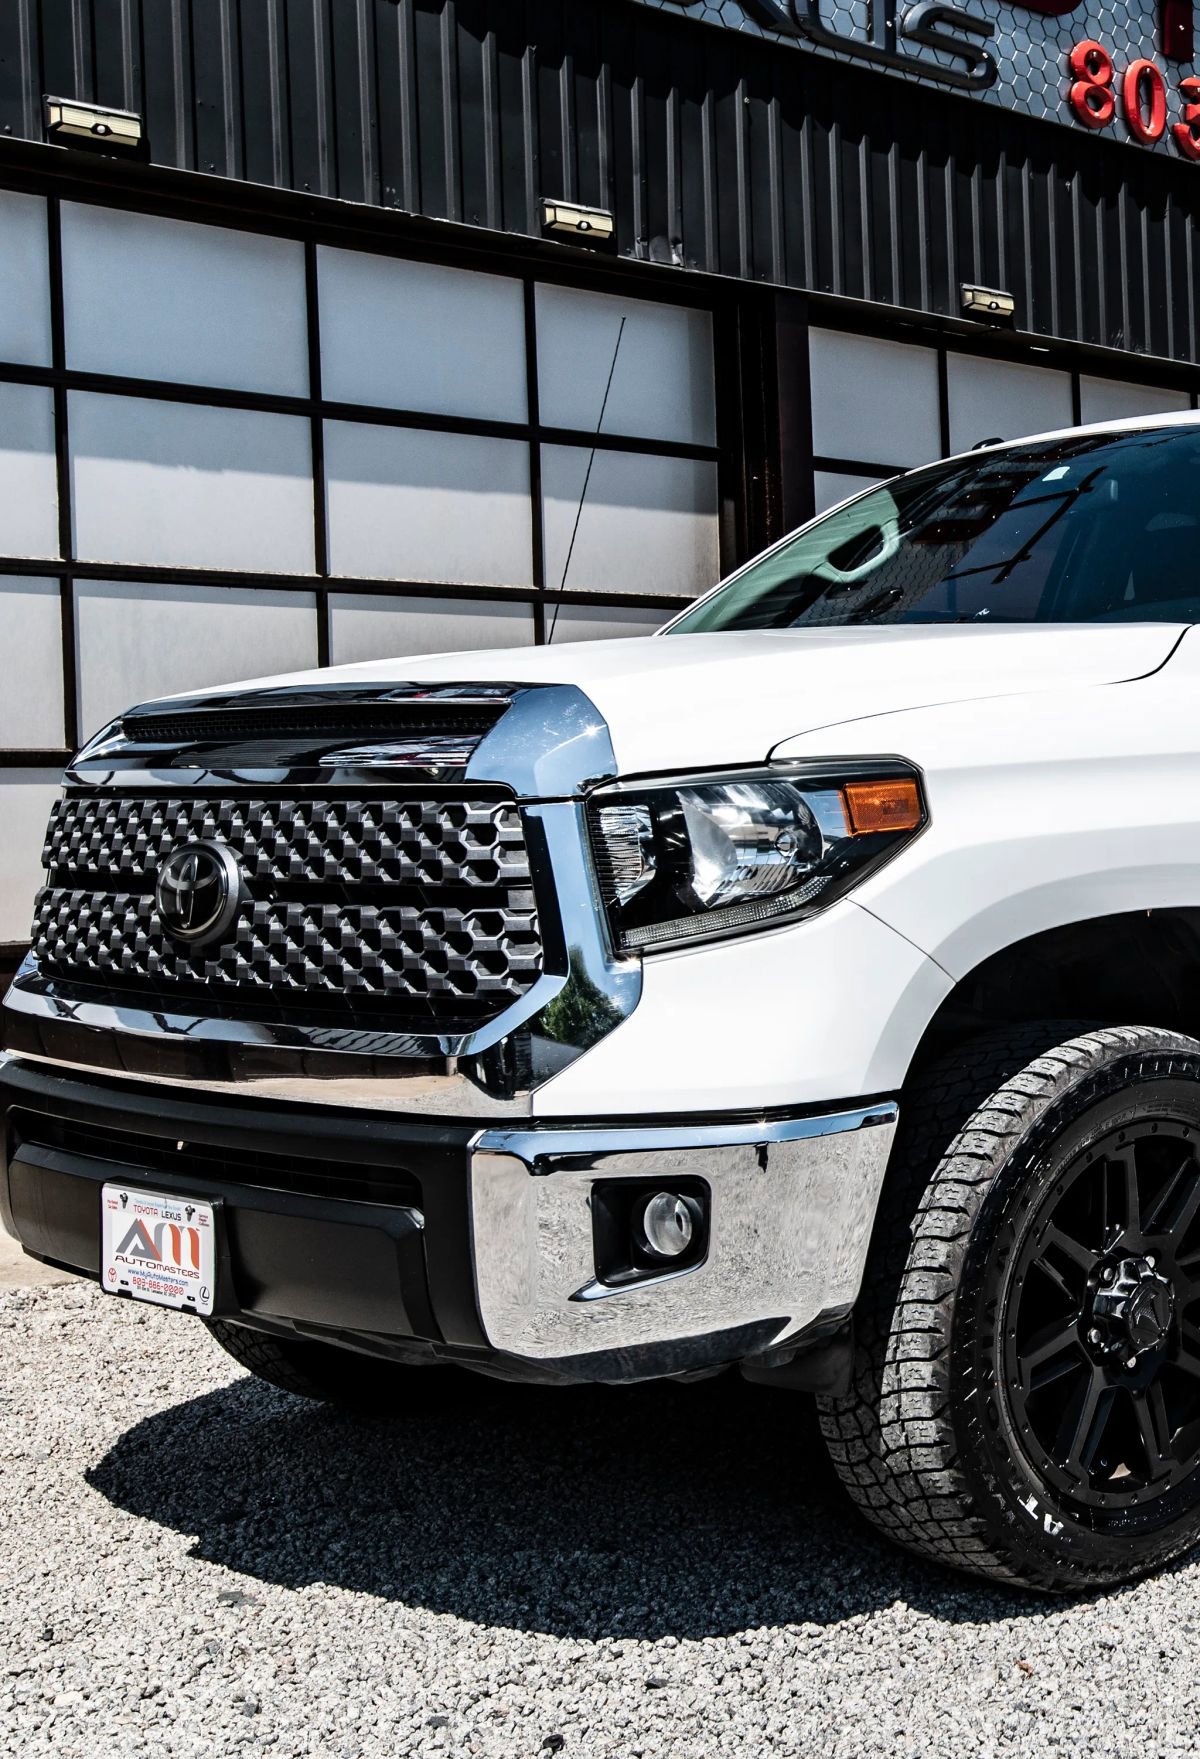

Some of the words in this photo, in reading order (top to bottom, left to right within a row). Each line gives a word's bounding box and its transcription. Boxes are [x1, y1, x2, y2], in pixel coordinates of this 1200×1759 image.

[132, 1204, 159, 1217] TOYOTA
[160, 1210, 182, 1222] LEXUS
[114, 1255, 200, 1279] AUTOMASTERS
